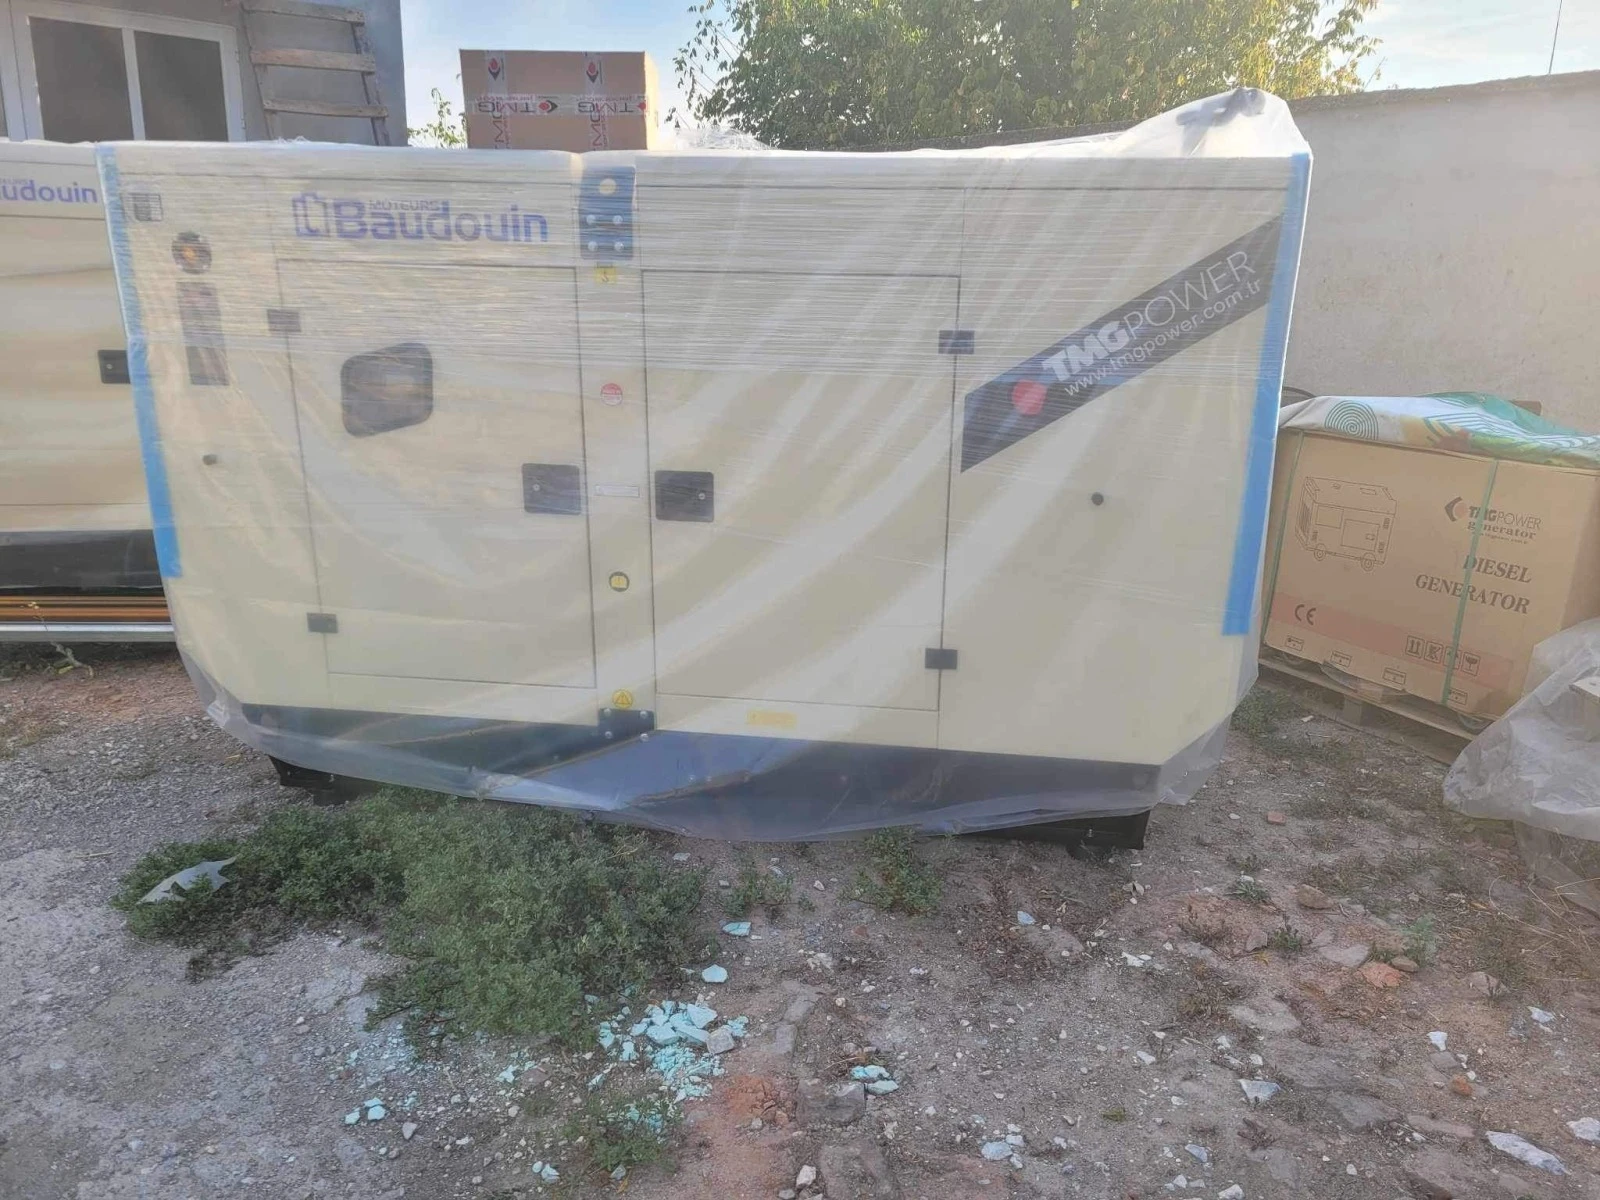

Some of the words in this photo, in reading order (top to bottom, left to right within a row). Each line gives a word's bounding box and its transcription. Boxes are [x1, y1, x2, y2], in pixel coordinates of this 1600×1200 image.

[0, 180, 98, 203] udouin
[333, 201, 549, 242] Baudouin
[1042, 251, 1256, 382] TMGPOWER
[1064, 278, 1261, 397] www.tmgpower.com.tr
[1467, 521, 1536, 540] gnerator
[1463, 555, 1532, 583] DIESEL
[1415, 574, 1530, 614] GENERATOR
